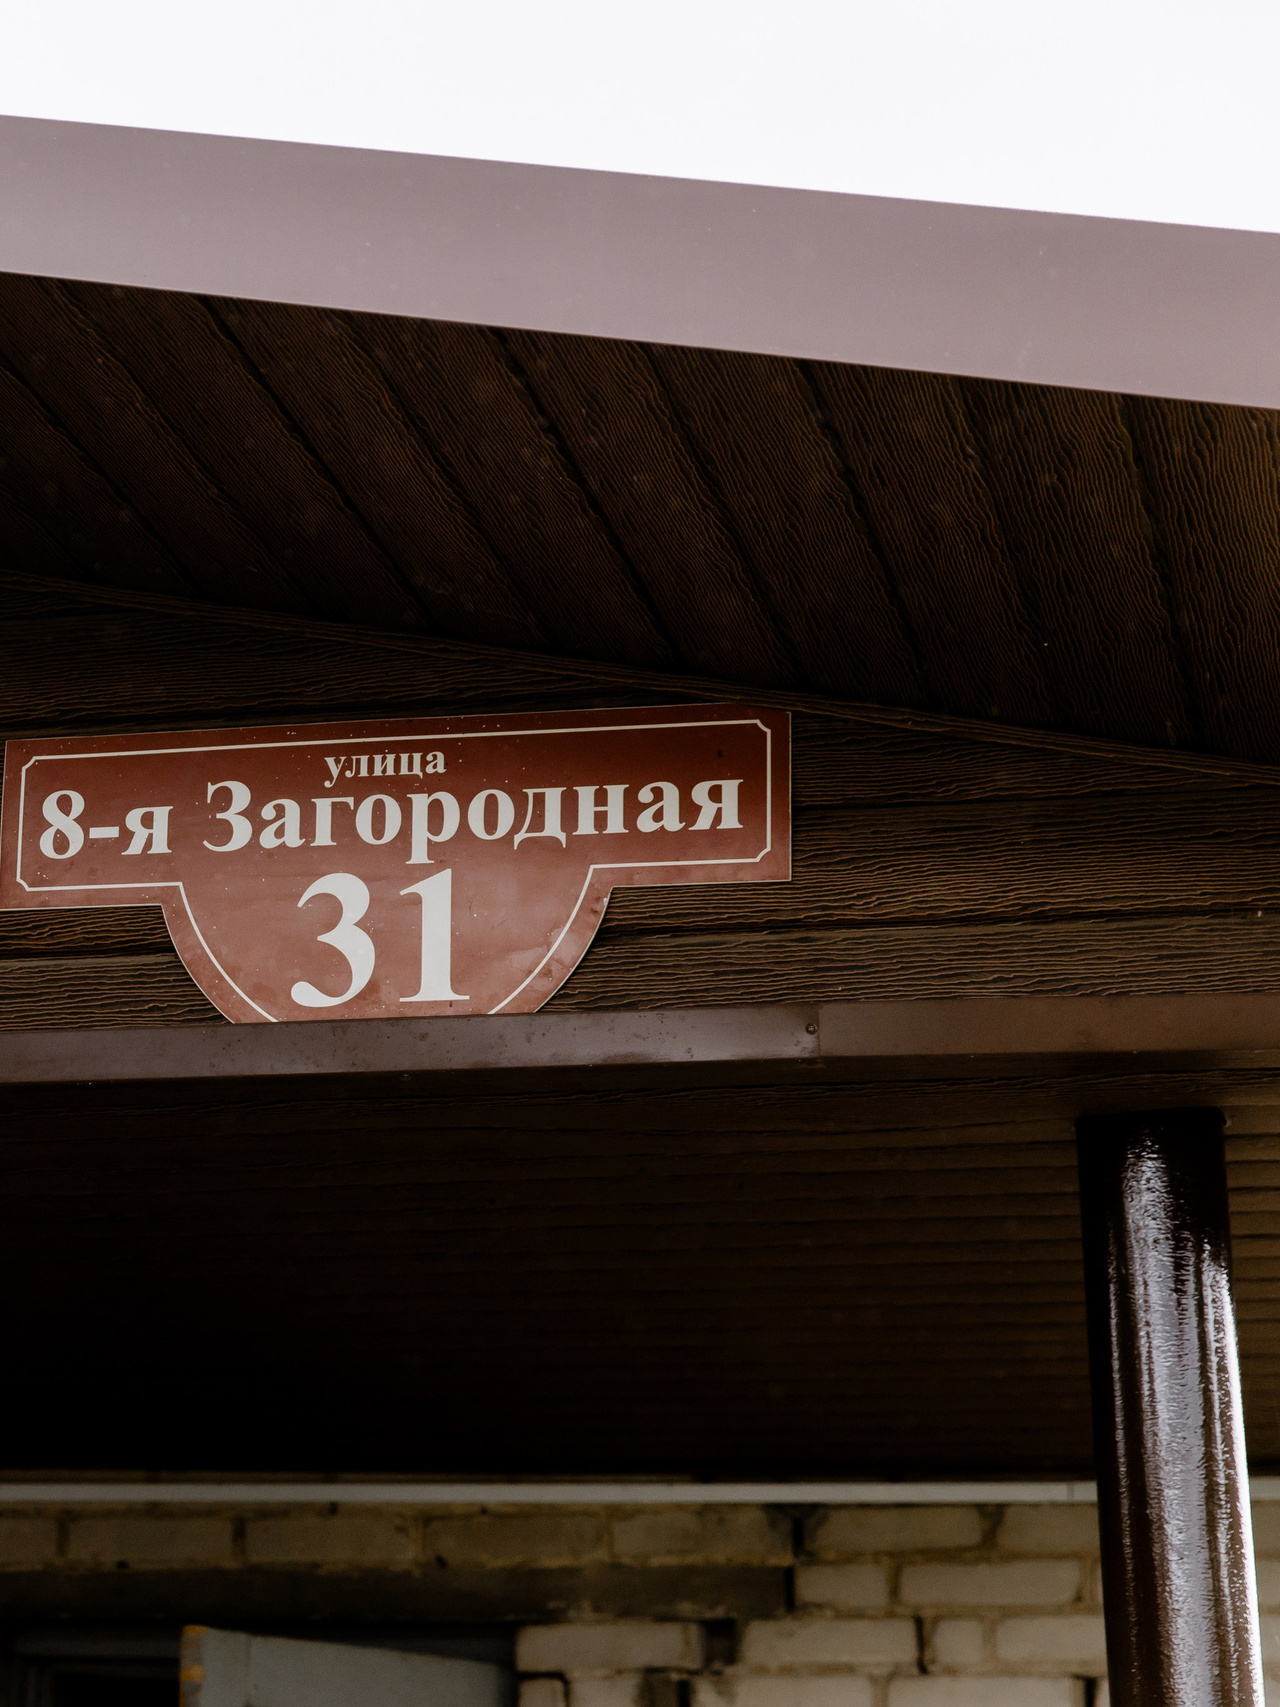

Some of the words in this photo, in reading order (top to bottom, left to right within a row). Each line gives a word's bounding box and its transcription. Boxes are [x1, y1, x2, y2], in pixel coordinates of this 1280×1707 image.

[323, 751, 447, 788] улица
[38, 789, 174, 859] 8-я
[202, 779, 744, 865] Загородная
[290, 868, 470, 1008] 31
